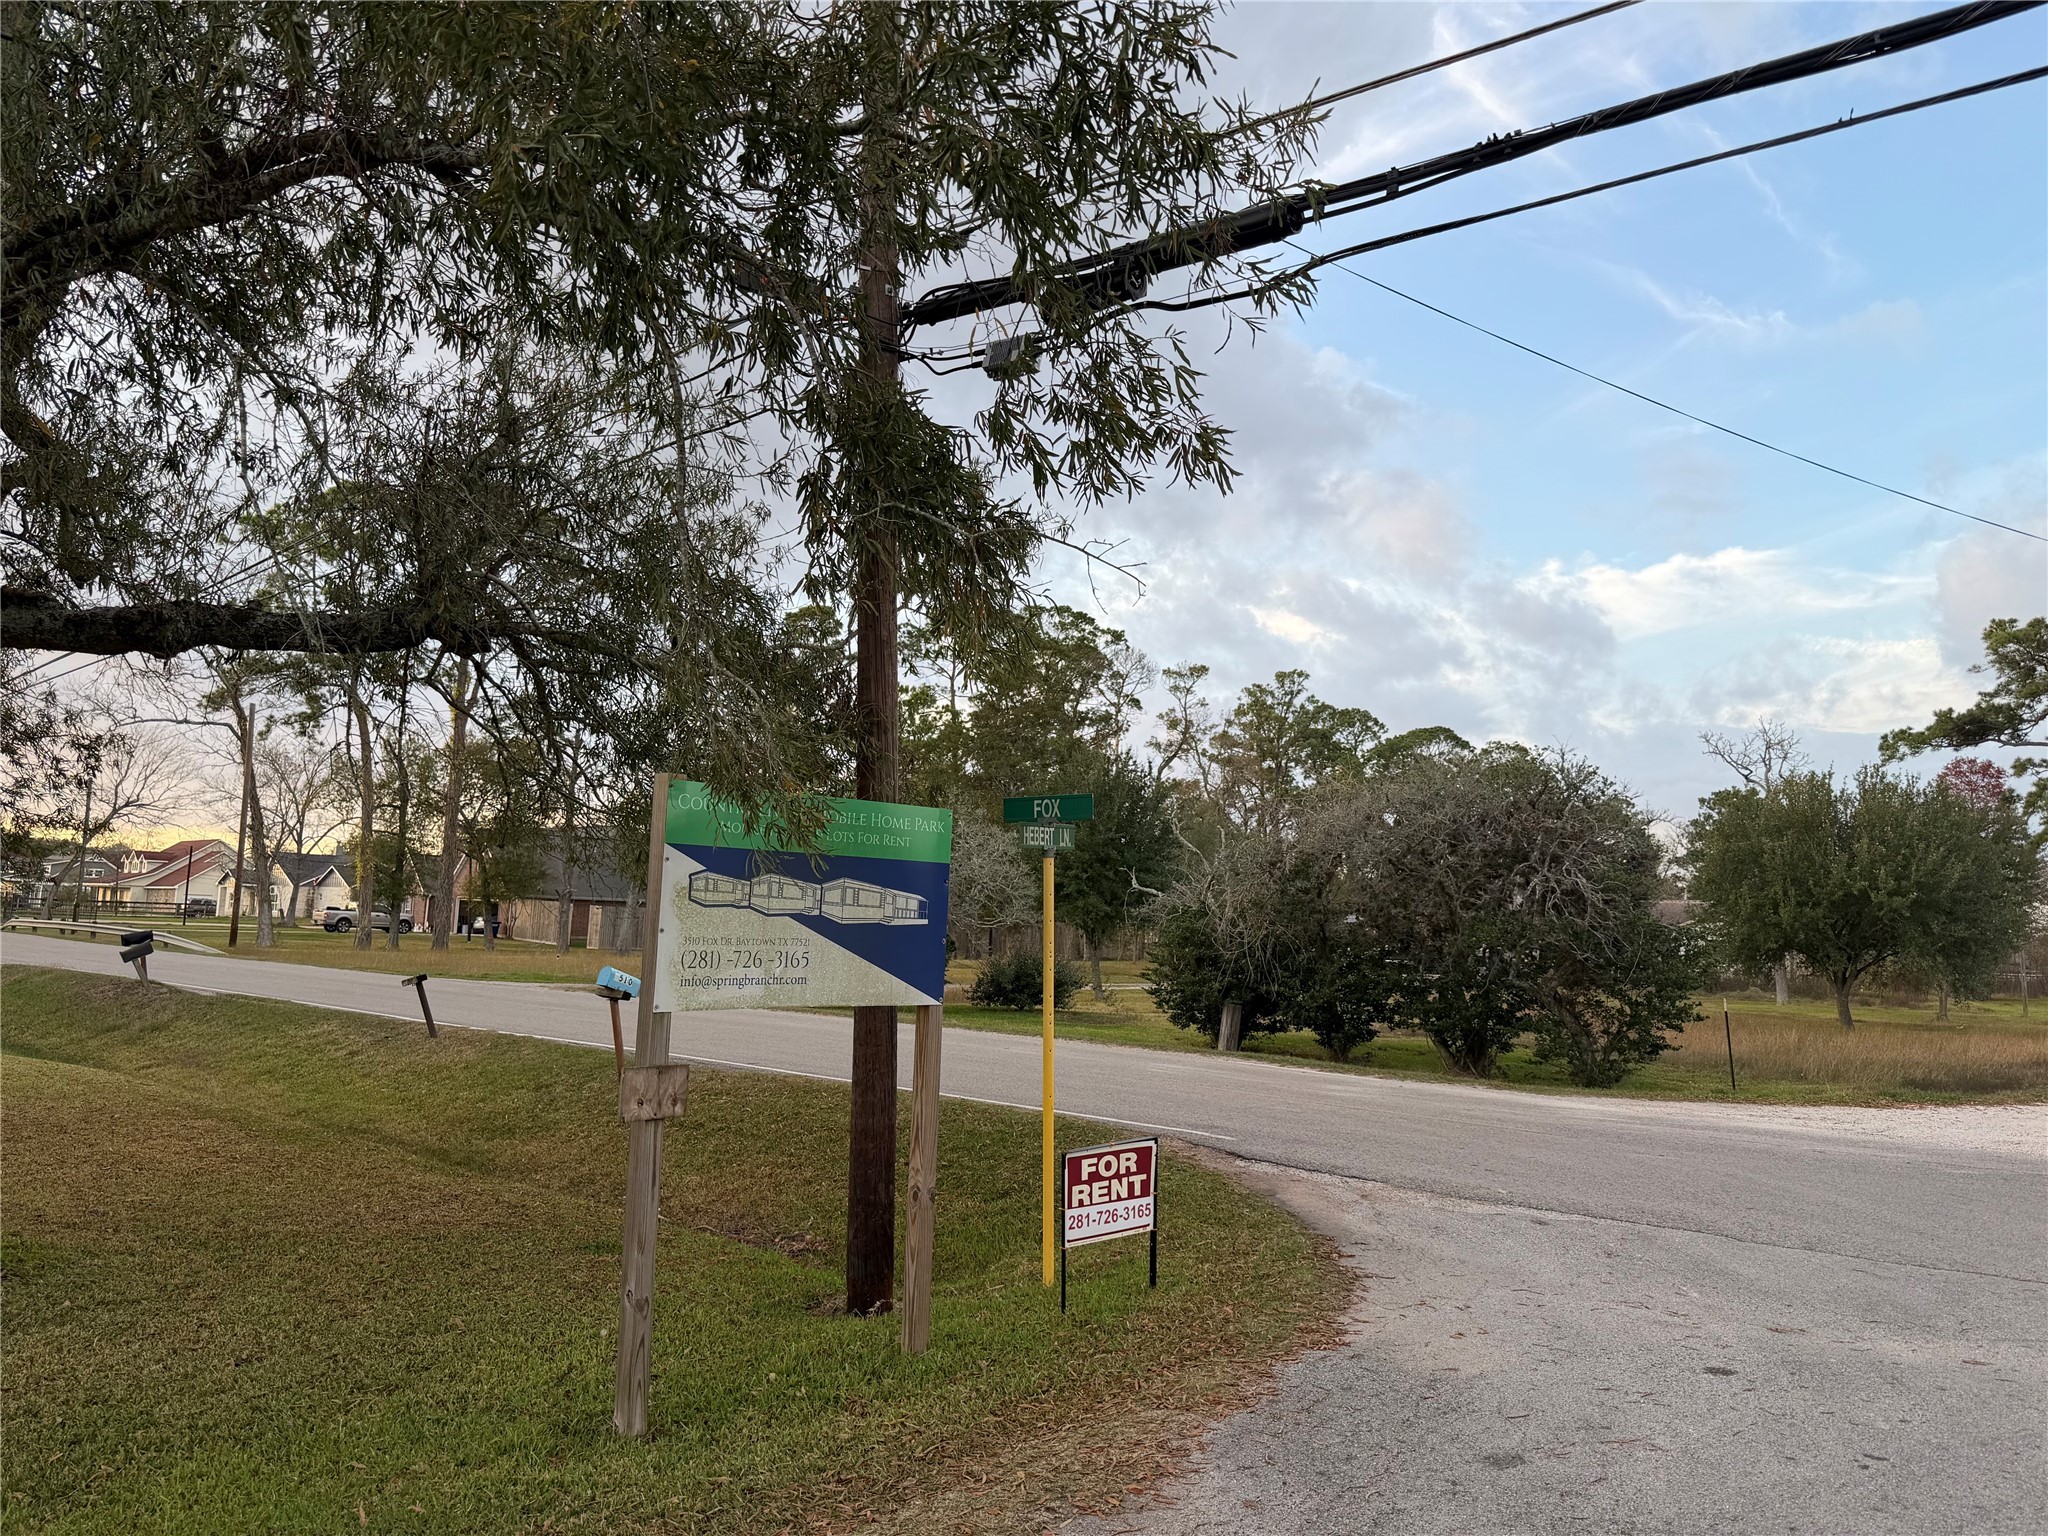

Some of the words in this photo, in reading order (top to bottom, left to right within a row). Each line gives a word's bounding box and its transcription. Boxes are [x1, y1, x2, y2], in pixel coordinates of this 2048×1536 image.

[1033, 799, 1061, 818] FOX
[871, 813, 911, 830] HOME
[915, 817, 945, 834] PARK
[858, 831, 880, 845] FOR
[883, 833, 912, 847] RENT
[1023, 826, 1055, 845] HEBERT
[702, 937, 719, 946] FOX
[778, 938, 788, 947] TX
[681, 950, 721, 971] (281)
[618, 974, 634, 986] 510
[680, 974, 808, 990] info@springbranchr.com
[1081, 1152, 1138, 1181] FOR
[1072, 1174, 1147, 1208] RENT
[1068, 1203, 1151, 1230] 281-726-3165
